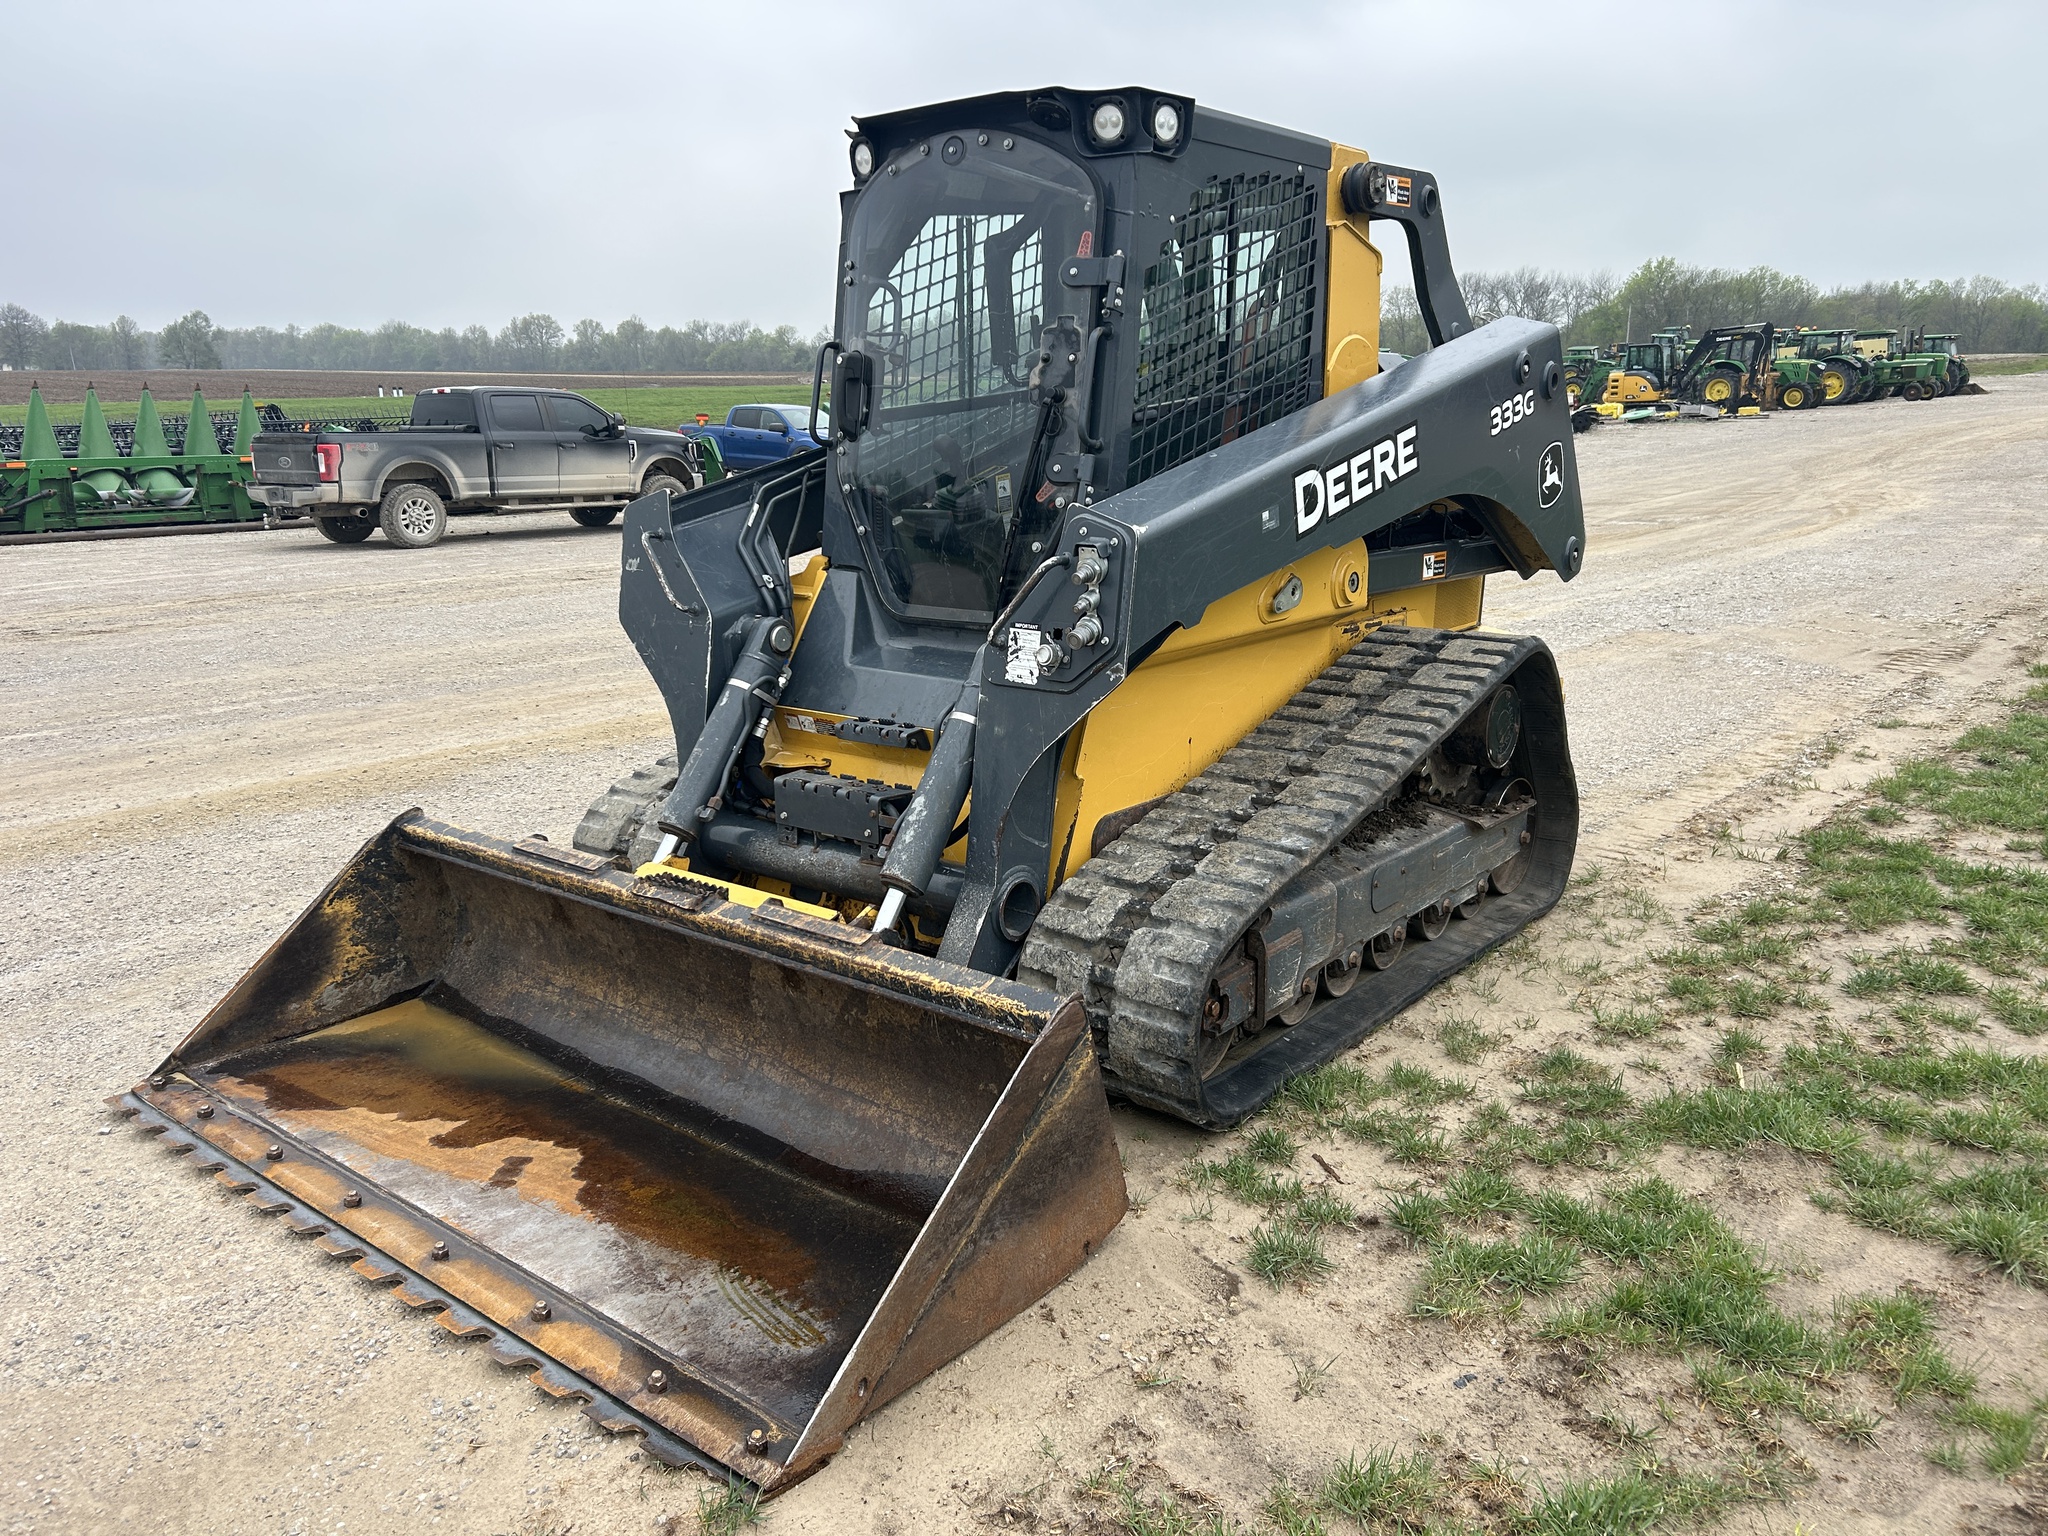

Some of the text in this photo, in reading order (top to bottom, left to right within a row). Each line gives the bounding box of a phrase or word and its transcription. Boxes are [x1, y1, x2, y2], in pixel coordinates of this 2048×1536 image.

[1490, 389, 1534, 436] 333G
[1294, 425, 1419, 534] DEERE
[1014, 622, 1039, 630] IMPORTANT
